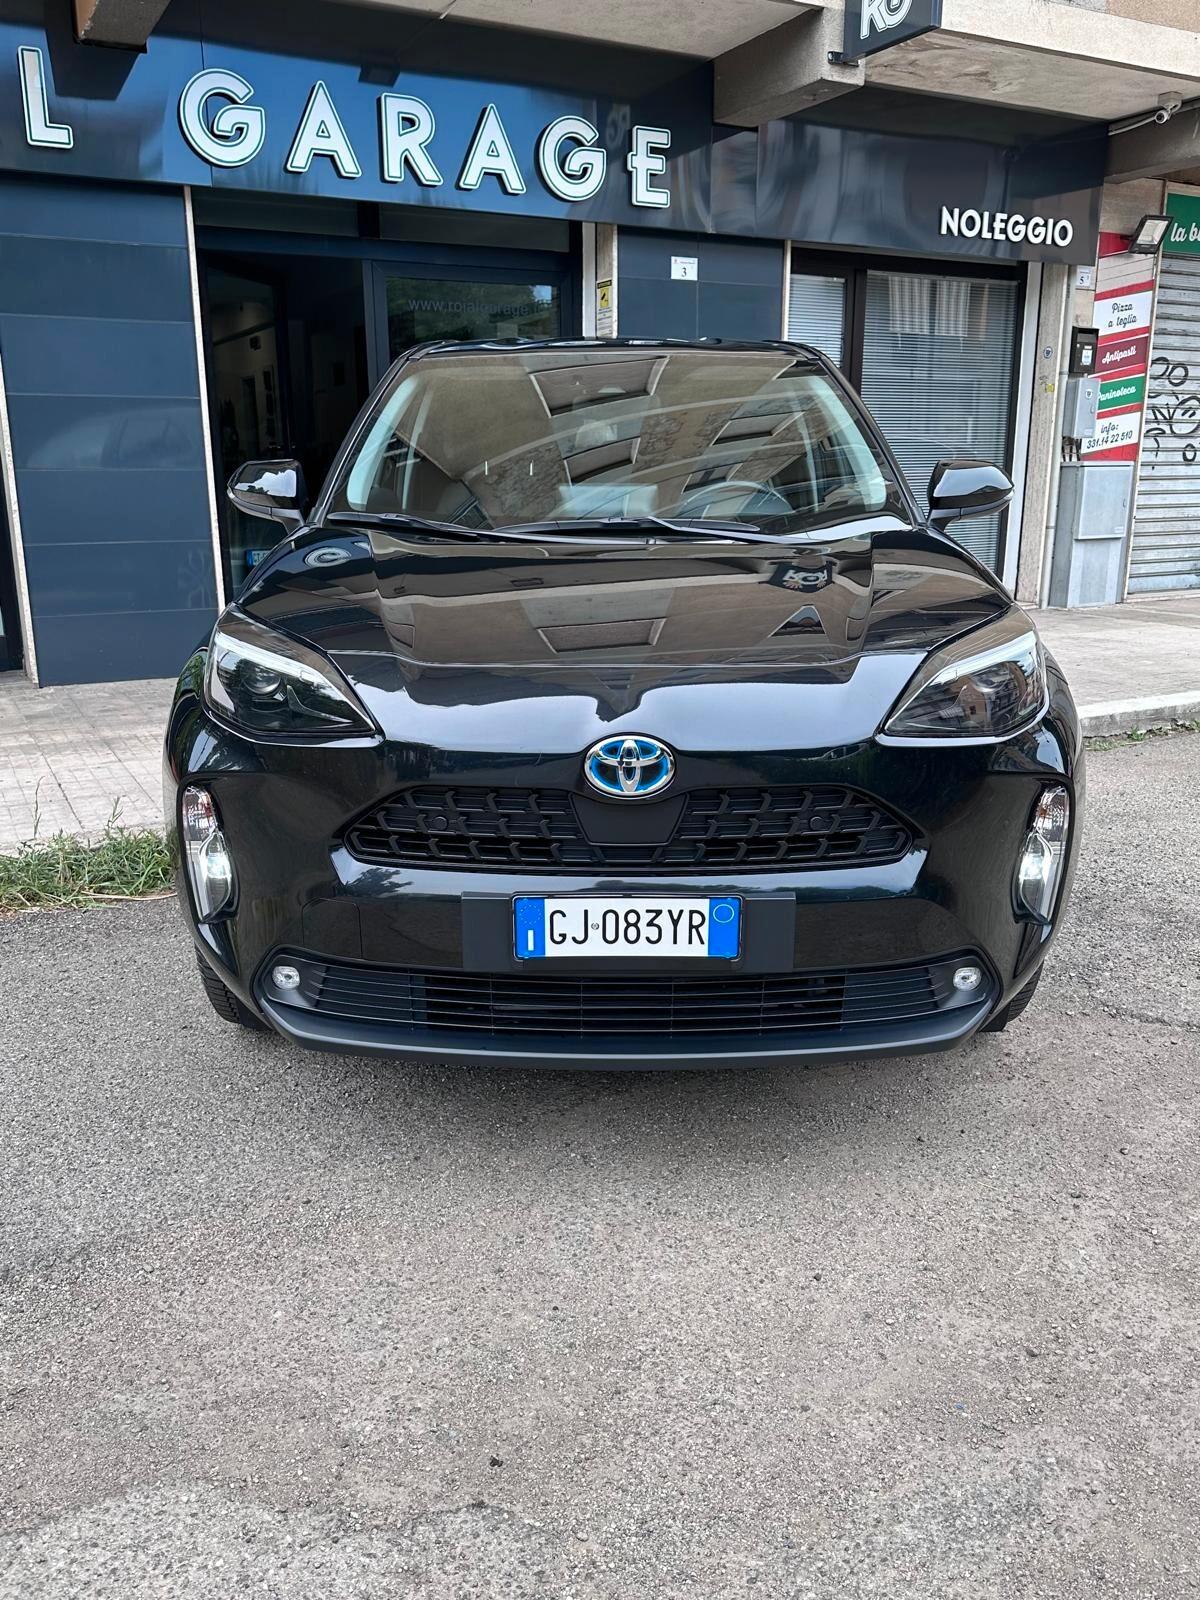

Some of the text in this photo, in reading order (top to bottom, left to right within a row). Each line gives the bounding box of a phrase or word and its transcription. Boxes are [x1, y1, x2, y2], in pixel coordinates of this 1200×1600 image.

[180, 68, 671, 208] GARAGE
[940, 206, 1073, 247] NOLEGGIO
[1170, 222, 1200, 242] la b
[1112, 302, 1134, 314] Pizza
[1108, 314, 1137, 328] a teglia
[1101, 345, 1137, 364] Antipasti
